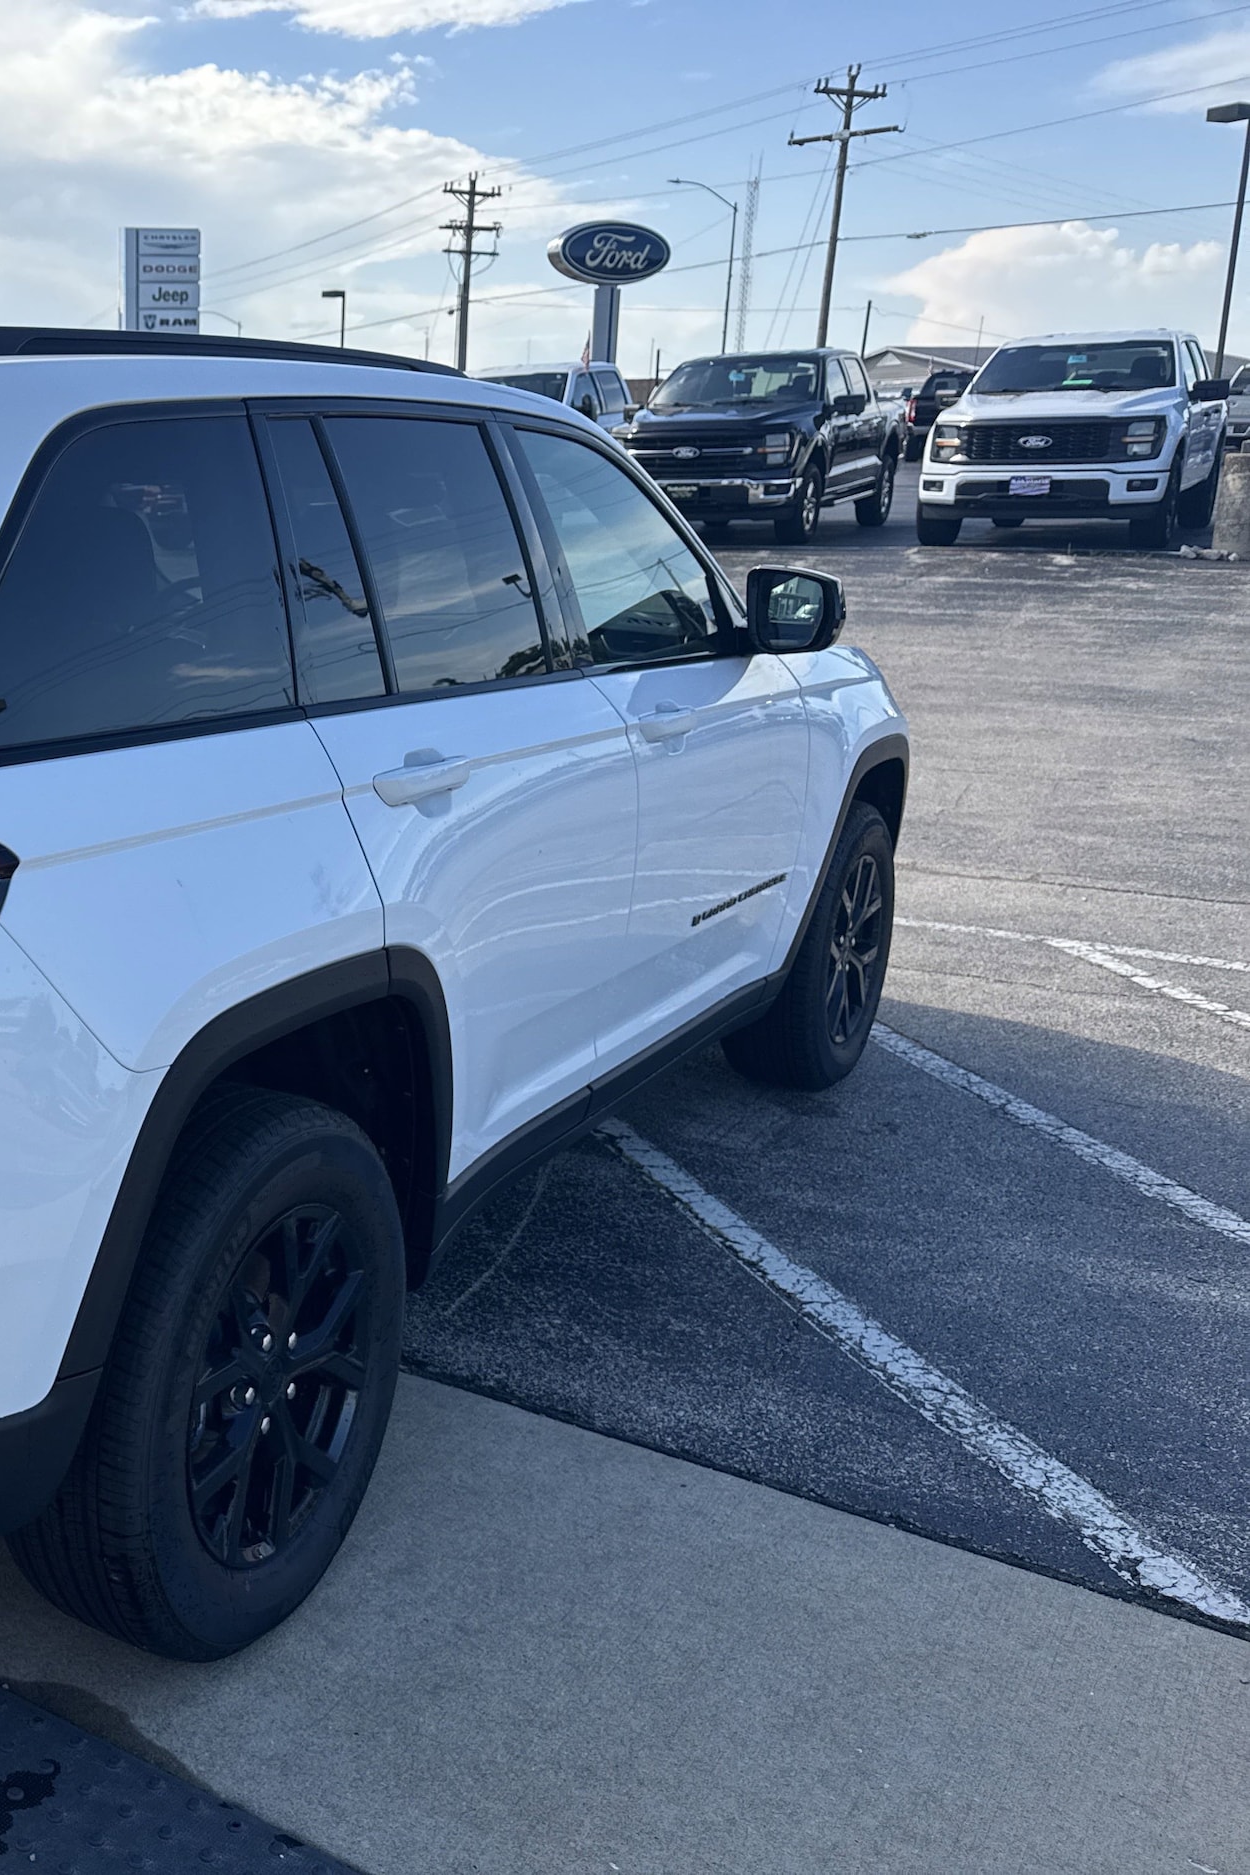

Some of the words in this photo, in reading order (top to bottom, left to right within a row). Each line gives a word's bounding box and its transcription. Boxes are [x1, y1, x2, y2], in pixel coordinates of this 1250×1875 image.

[585, 231, 651, 270] Ford
[142, 264, 197, 274] DODGE
[152, 286, 189, 305] Jeep
[159, 317, 197, 327] RAM
[1022, 436, 1050, 448] Ford
